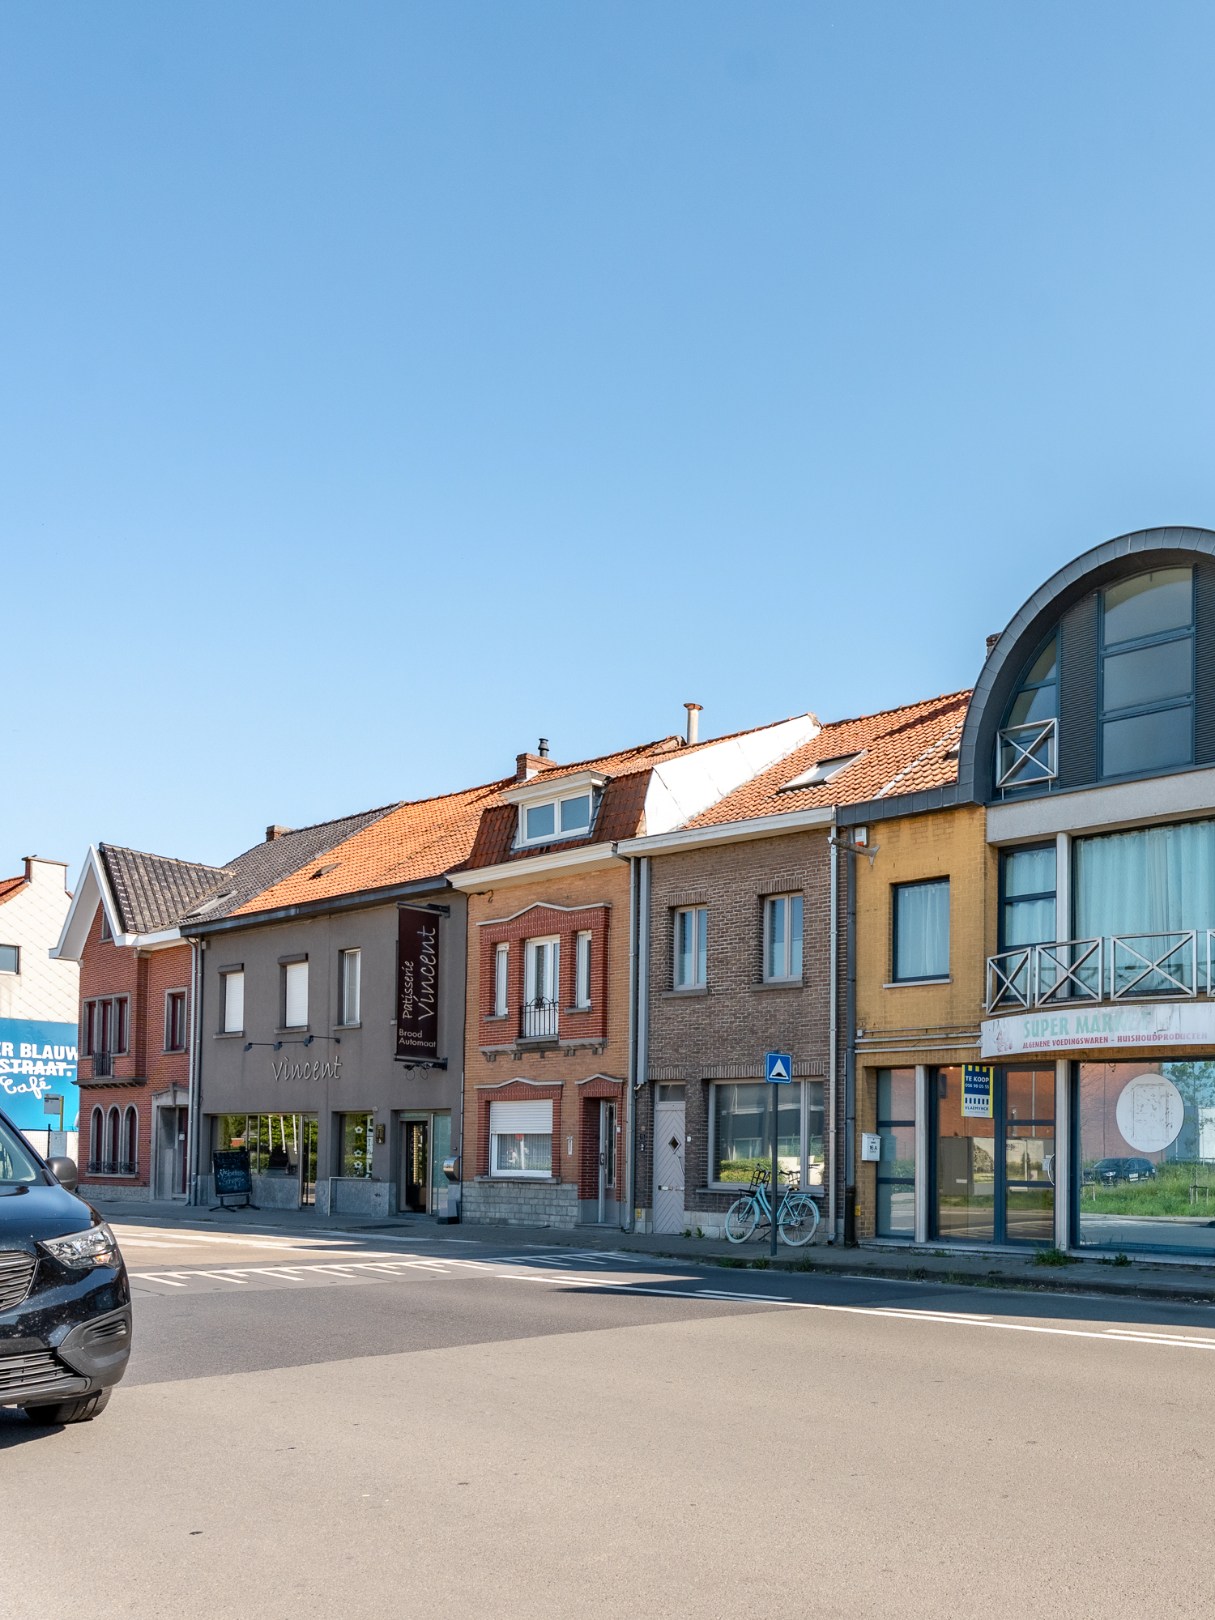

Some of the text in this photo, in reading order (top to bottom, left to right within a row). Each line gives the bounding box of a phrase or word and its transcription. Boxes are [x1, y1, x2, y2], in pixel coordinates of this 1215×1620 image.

[413, 925, 436, 1021] Vincent
[399, 1028, 422, 1038] Brood
[1023, 1016, 1070, 1039] SUPER
[399, 1036, 436, 1048] Automaat
[1052, 1036, 1109, 1047] VOEDINGSWAREN
[1117, 1031, 1208, 1043] HUISHOUDPRODUCTEN
[0, 1042, 78, 1060] R BLAUW
